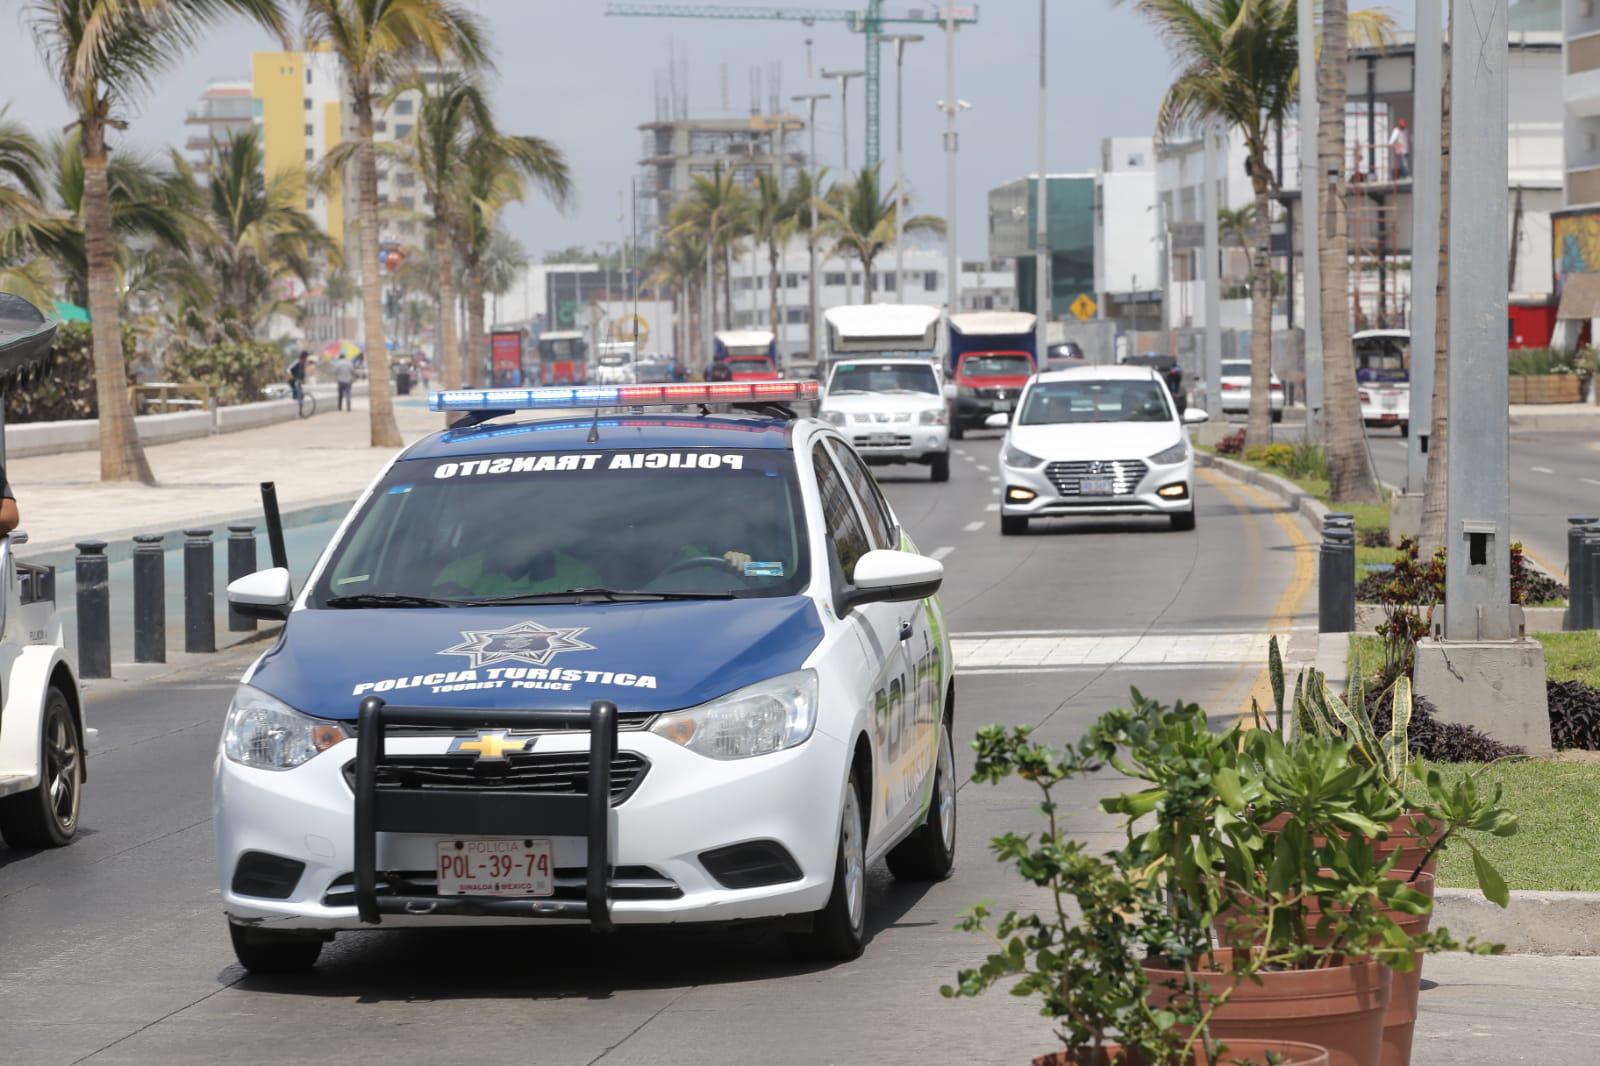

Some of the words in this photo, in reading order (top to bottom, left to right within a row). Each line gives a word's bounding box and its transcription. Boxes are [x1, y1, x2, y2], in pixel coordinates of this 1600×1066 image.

[352, 669, 479, 696] POLICIA
[486, 667, 658, 689] TURÍSTICA
[431, 680, 507, 694] TOURIST
[514, 680, 573, 691] POLICE
[468, 842, 519, 854] POLICIA
[441, 854, 549, 880] POL-39-74
[459, 882, 493, 891] SINALOA
